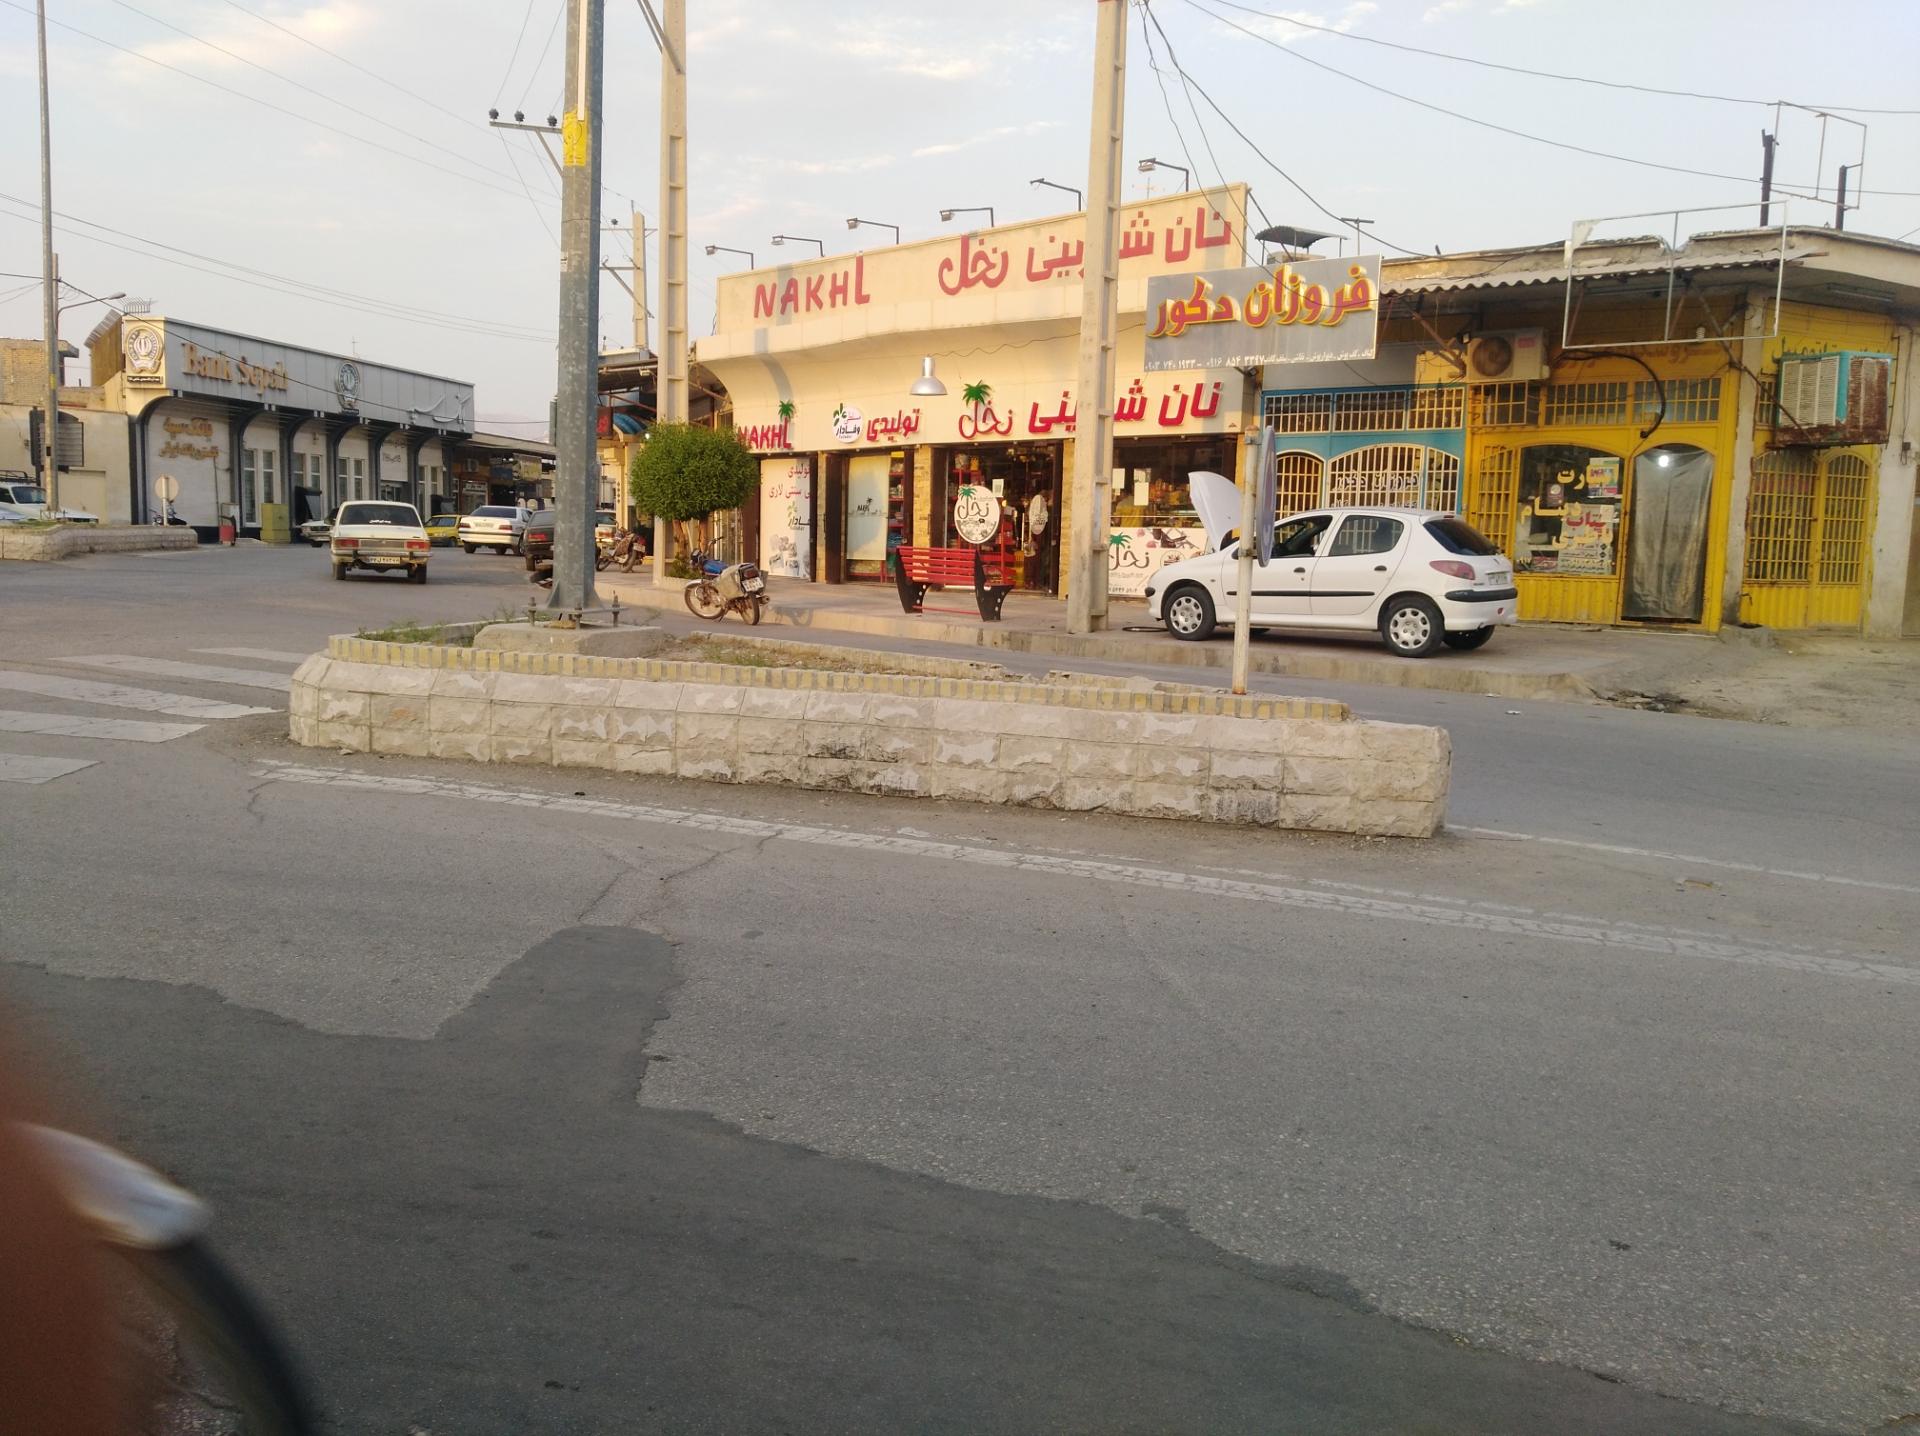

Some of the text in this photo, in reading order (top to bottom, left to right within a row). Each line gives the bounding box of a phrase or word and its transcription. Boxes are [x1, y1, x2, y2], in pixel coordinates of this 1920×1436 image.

[938, 206, 1231, 296] نان شینی نخل
[753, 255, 870, 318] NAKHL
[1147, 263, 1376, 338] فروزان دکور
[182, 343, 232, 383] Bank
[737, 416, 793, 449] NAKHL
[866, 408, 920, 443] تولیدی
[958, 378, 1223, 440] نان شینی نخل
[957, 496, 990, 520] نخل
